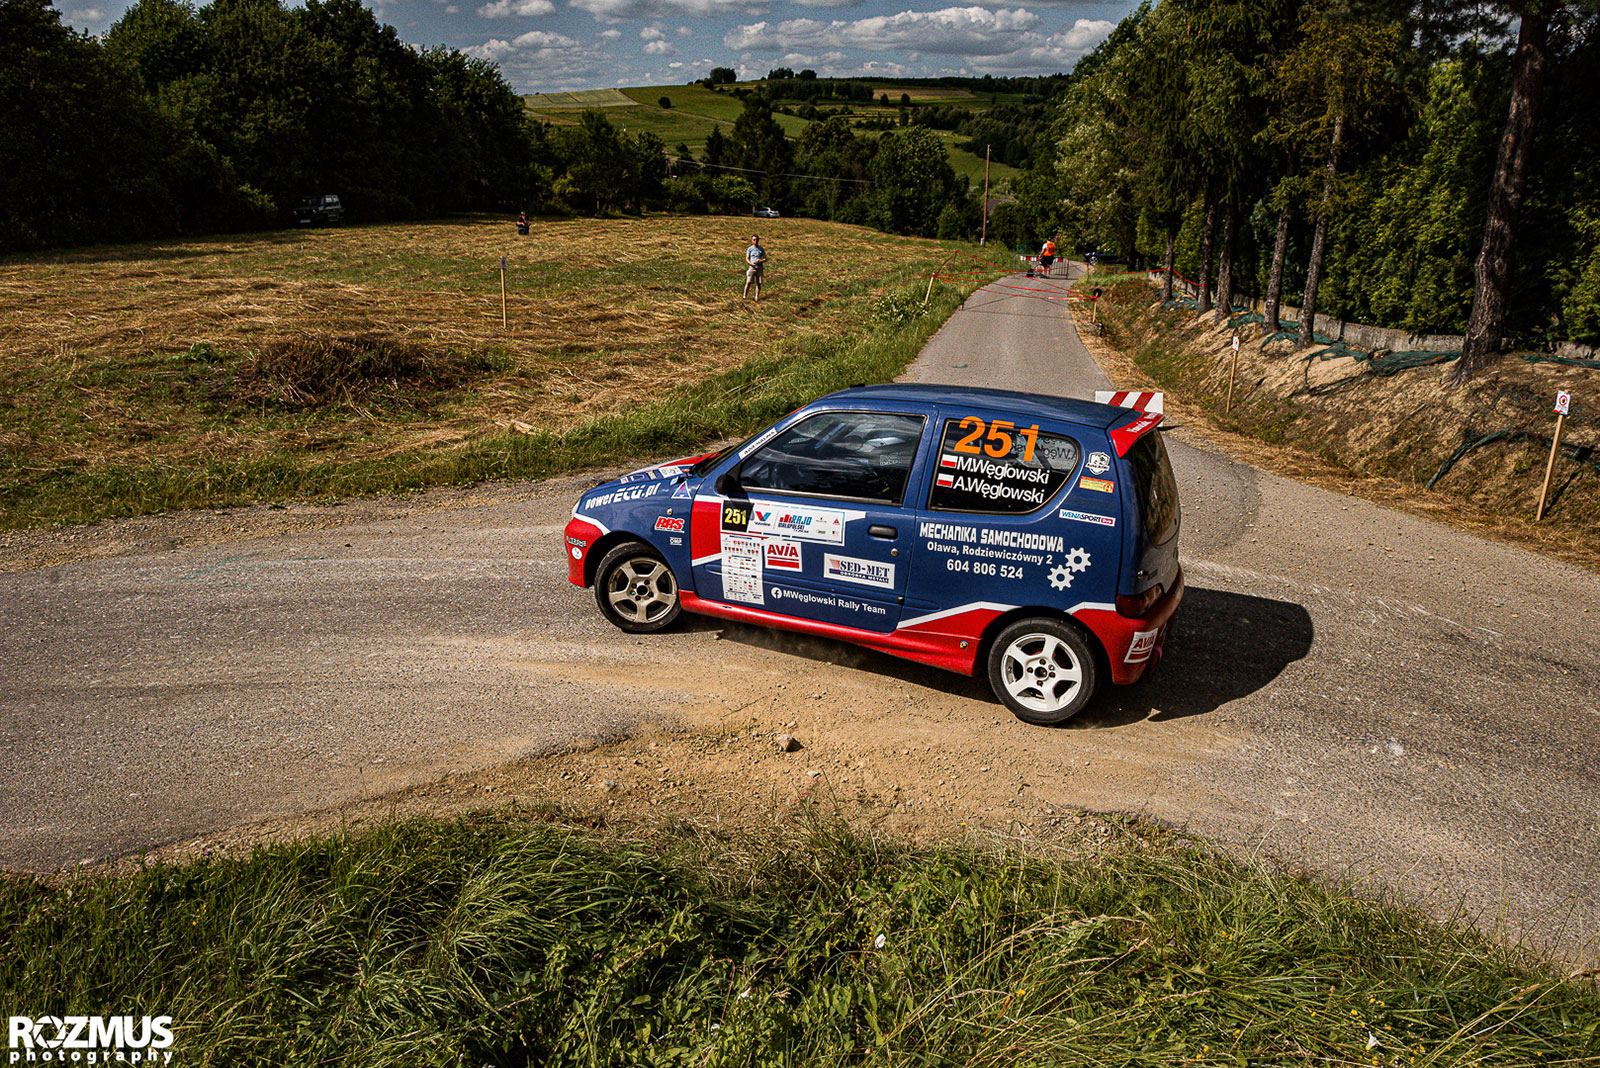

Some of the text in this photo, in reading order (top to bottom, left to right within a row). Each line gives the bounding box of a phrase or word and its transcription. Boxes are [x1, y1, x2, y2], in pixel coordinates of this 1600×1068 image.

[953, 416, 1040, 462] 251
[724, 507, 747, 525] 251
[919, 521, 1064, 553] MECHANIKA SAMOCHODOWA
[927, 541, 1053, 566] Oława, Rodziewiczówny 2
[840, 560, 890, 578] SED-MET
[946, 558, 1024, 580] 604 806 524
[838, 599, 860, 612] Rally
[862, 603, 886, 615] Team
